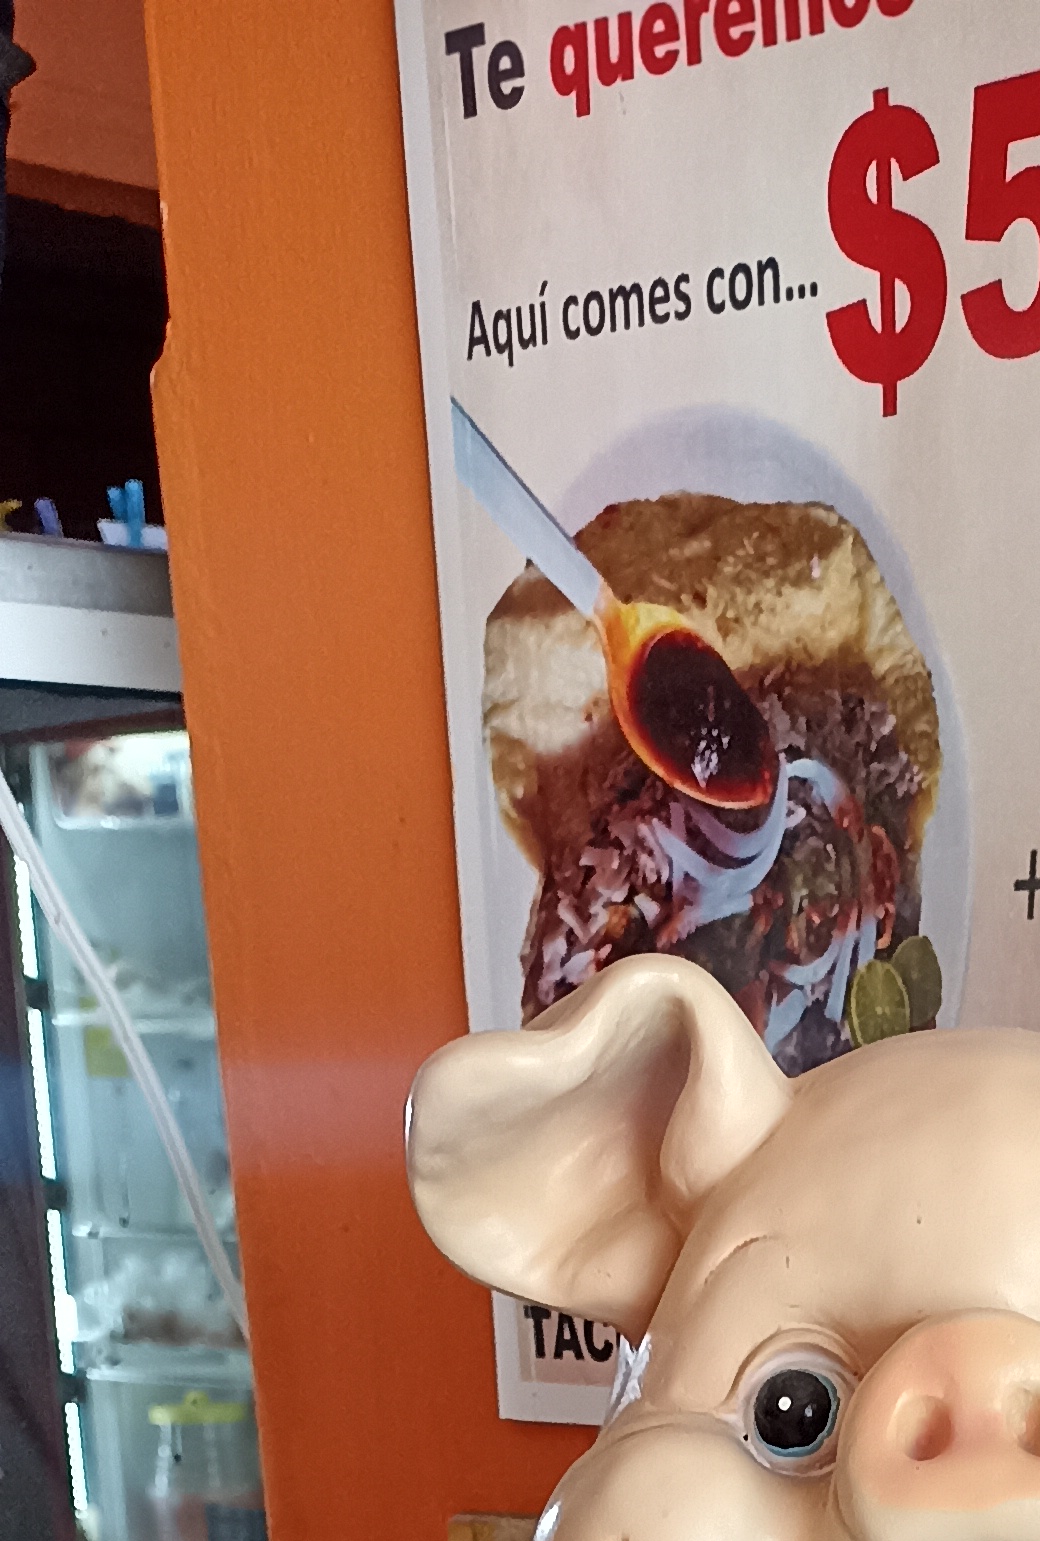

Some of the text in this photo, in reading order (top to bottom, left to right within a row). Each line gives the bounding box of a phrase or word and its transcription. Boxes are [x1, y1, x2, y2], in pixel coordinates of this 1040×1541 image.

[445, 0, 914, 119] Te querem
[467, 256, 819, 367] Aquí comes con...
